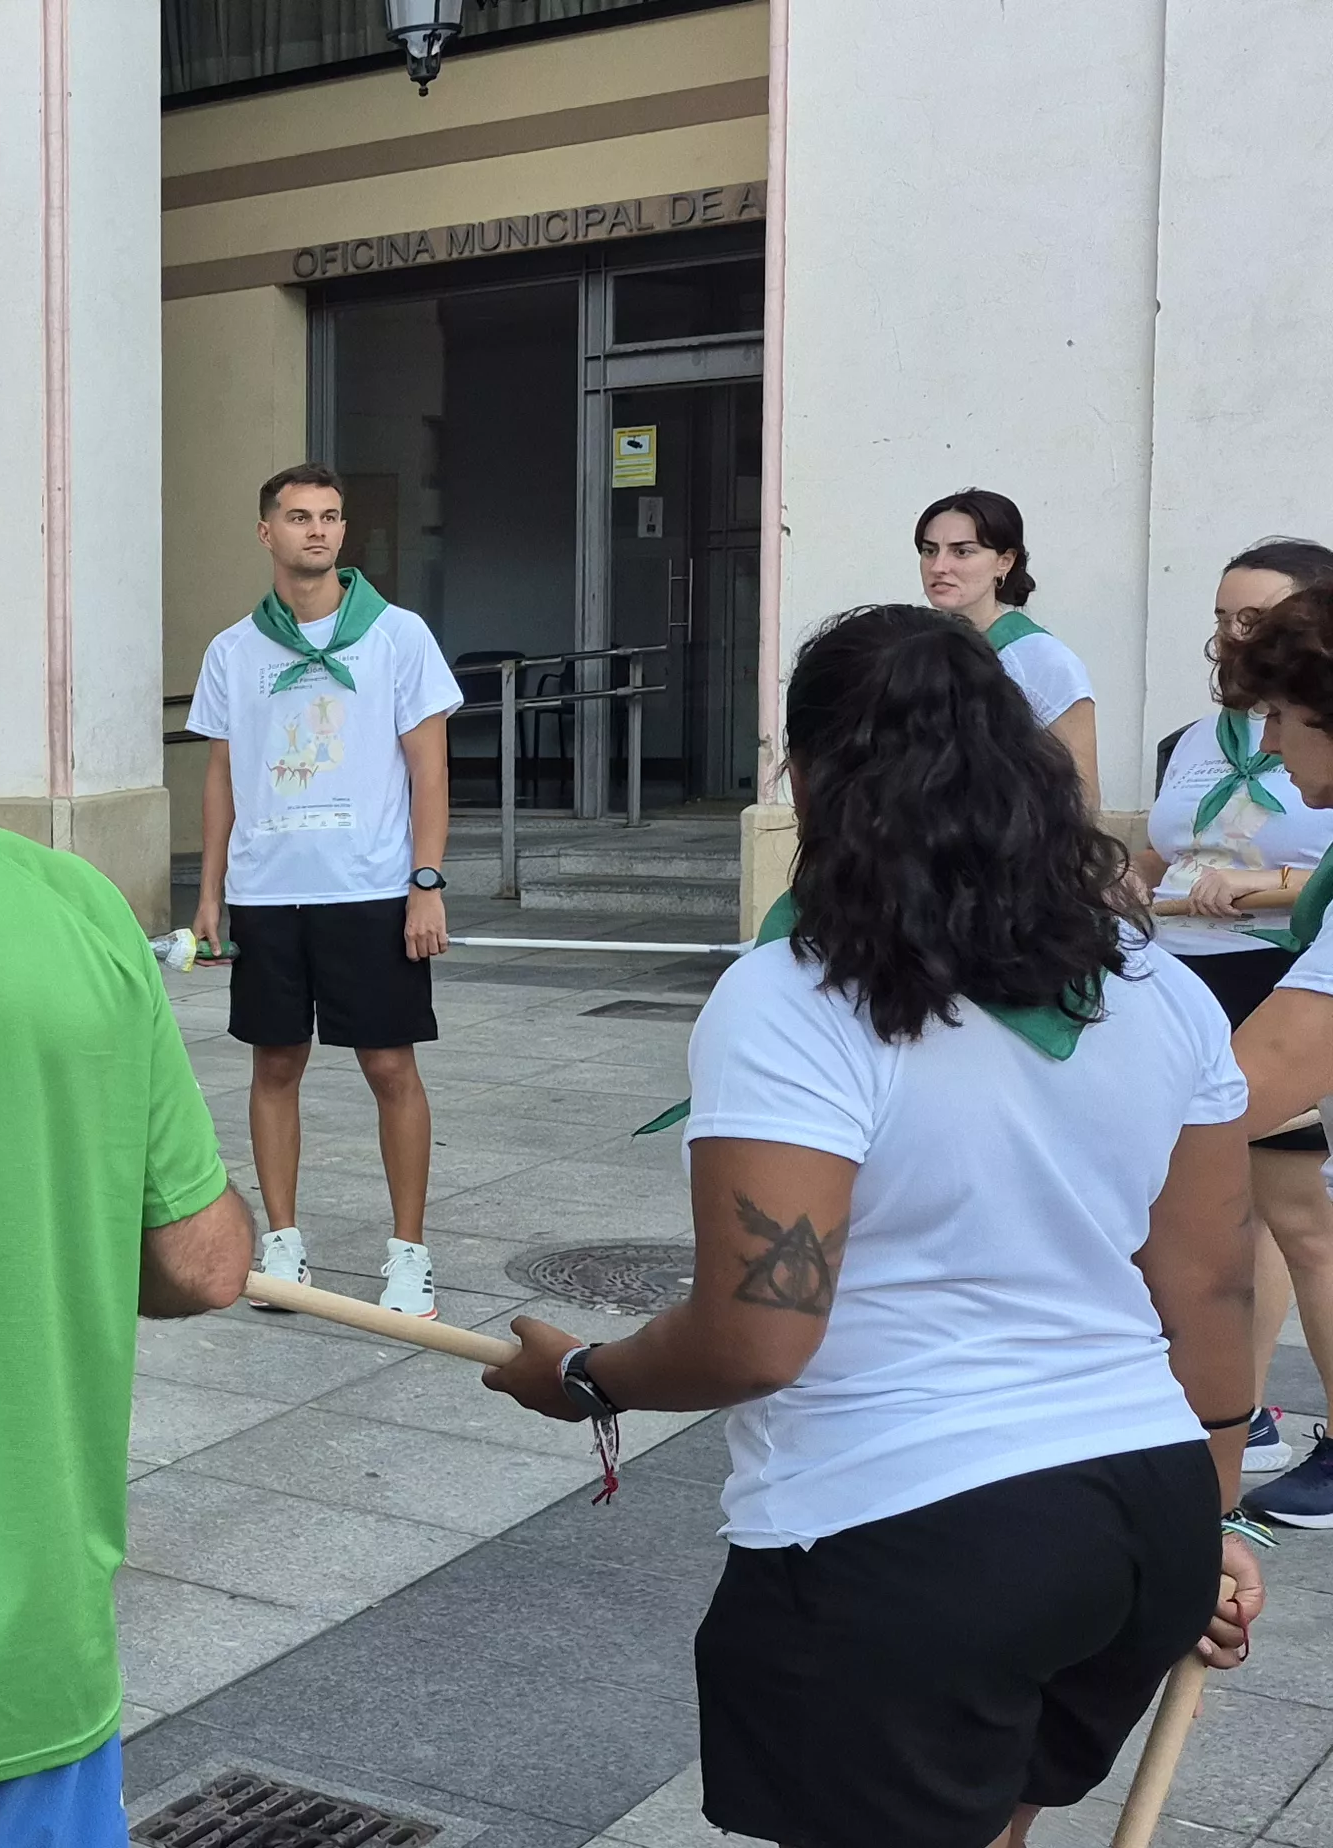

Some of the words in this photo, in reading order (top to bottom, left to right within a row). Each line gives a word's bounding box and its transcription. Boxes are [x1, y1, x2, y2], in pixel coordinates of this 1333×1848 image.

[293, 230, 437, 279] OFICINA
[446, 200, 654, 258] MUNICIPAL
[668, 188, 725, 227] DE
